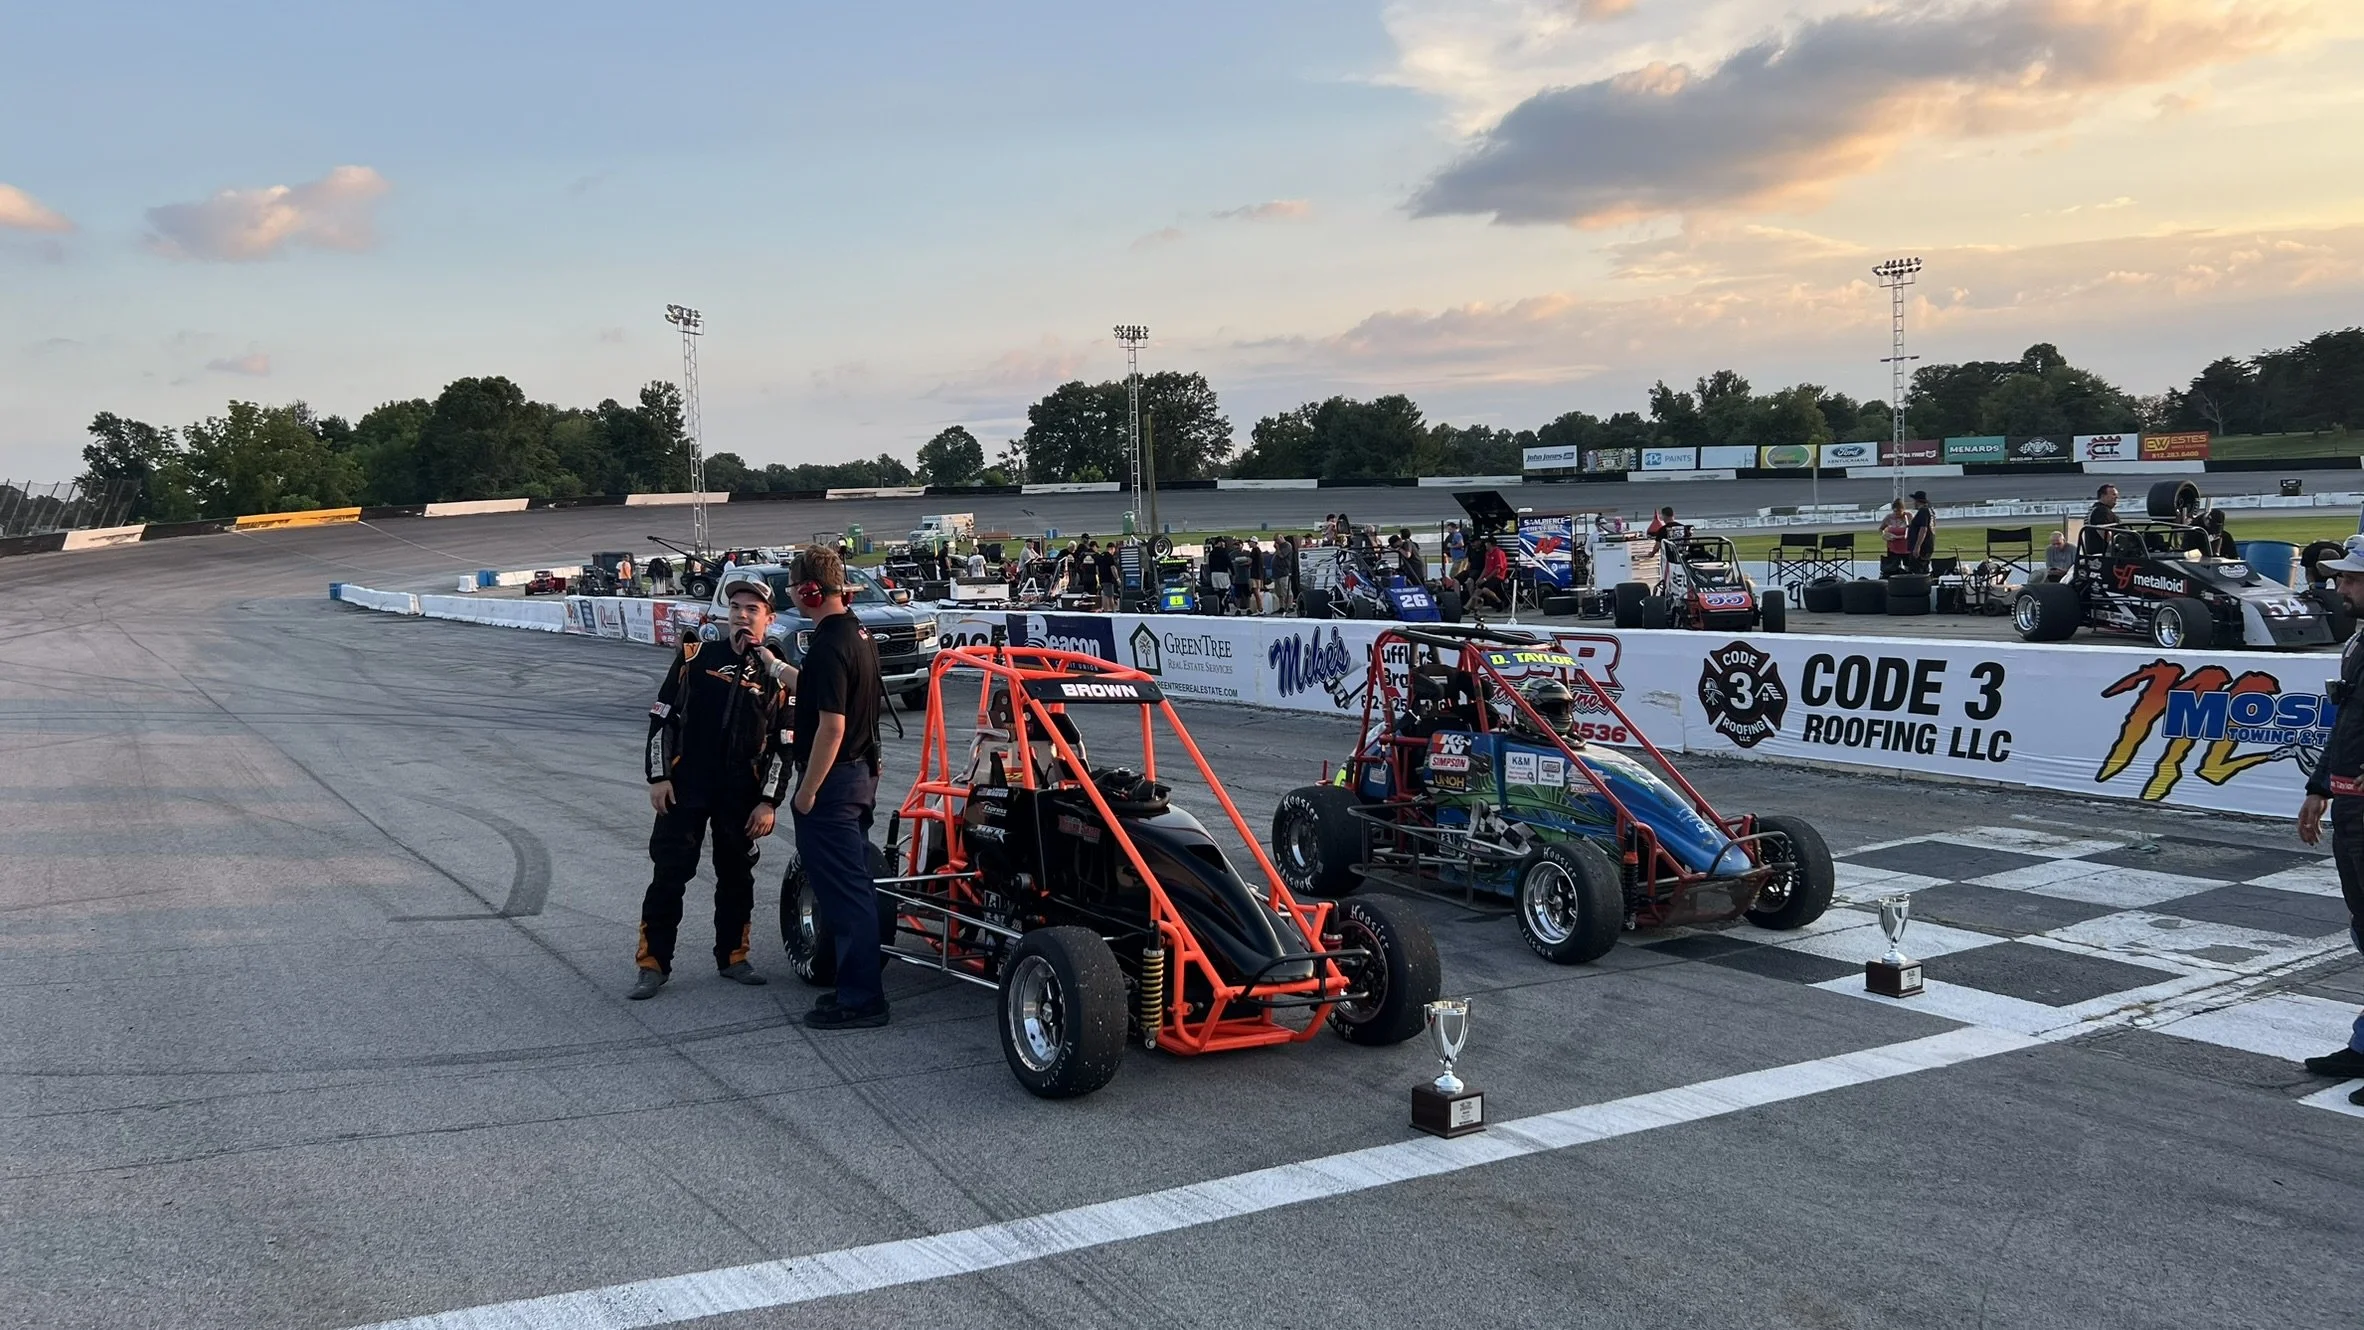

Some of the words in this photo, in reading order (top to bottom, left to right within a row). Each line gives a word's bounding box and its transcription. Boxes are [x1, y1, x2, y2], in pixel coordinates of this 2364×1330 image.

[2171, 435, 2207, 443] ESTES
[1526, 454, 1543, 462] John
[1543, 453, 1562, 461] Jones
[1949, 445, 2000, 453] MENARDS
[1645, 453, 1661, 465] PPG
[2133, 574, 2184, 594] metalloid
[1399, 593, 1429, 608] 26
[1269, 626, 1351, 698] Mike's
[1366, 643, 1435, 665] Mufflrs
[1489, 653, 1511, 665] D.
[1513, 652, 1577, 666] TAYLOR
[1722, 650, 1758, 668] CODE
[1168, 658, 1183, 670] REAL
[1183, 660, 1206, 673] ESTATE
[1206, 661, 1233, 674] SERVICES
[1060, 683, 1139, 698] BROWN
[1729, 671, 1755, 711] 3
[1800, 653, 1948, 716] CODE
[1964, 661, 2006, 721] 3
[1721, 717, 1767, 738] ROOFING
[2227, 726, 2295, 745] TOWING
[2298, 727, 2314, 746] &
[1739, 735, 1752, 743] LLC
[1803, 713, 1939, 756] ROOFING
[1947, 726, 2013, 763] LLC
[1432, 756, 1467, 768] SIMPSON
[1512, 756, 1531, 766] K&M
[1434, 775, 1465, 787] UNOH
[1283, 794, 1320, 821] Hoosier
[1543, 846, 1577, 879] Hoosier
[1349, 904, 1390, 949] Hoosier
